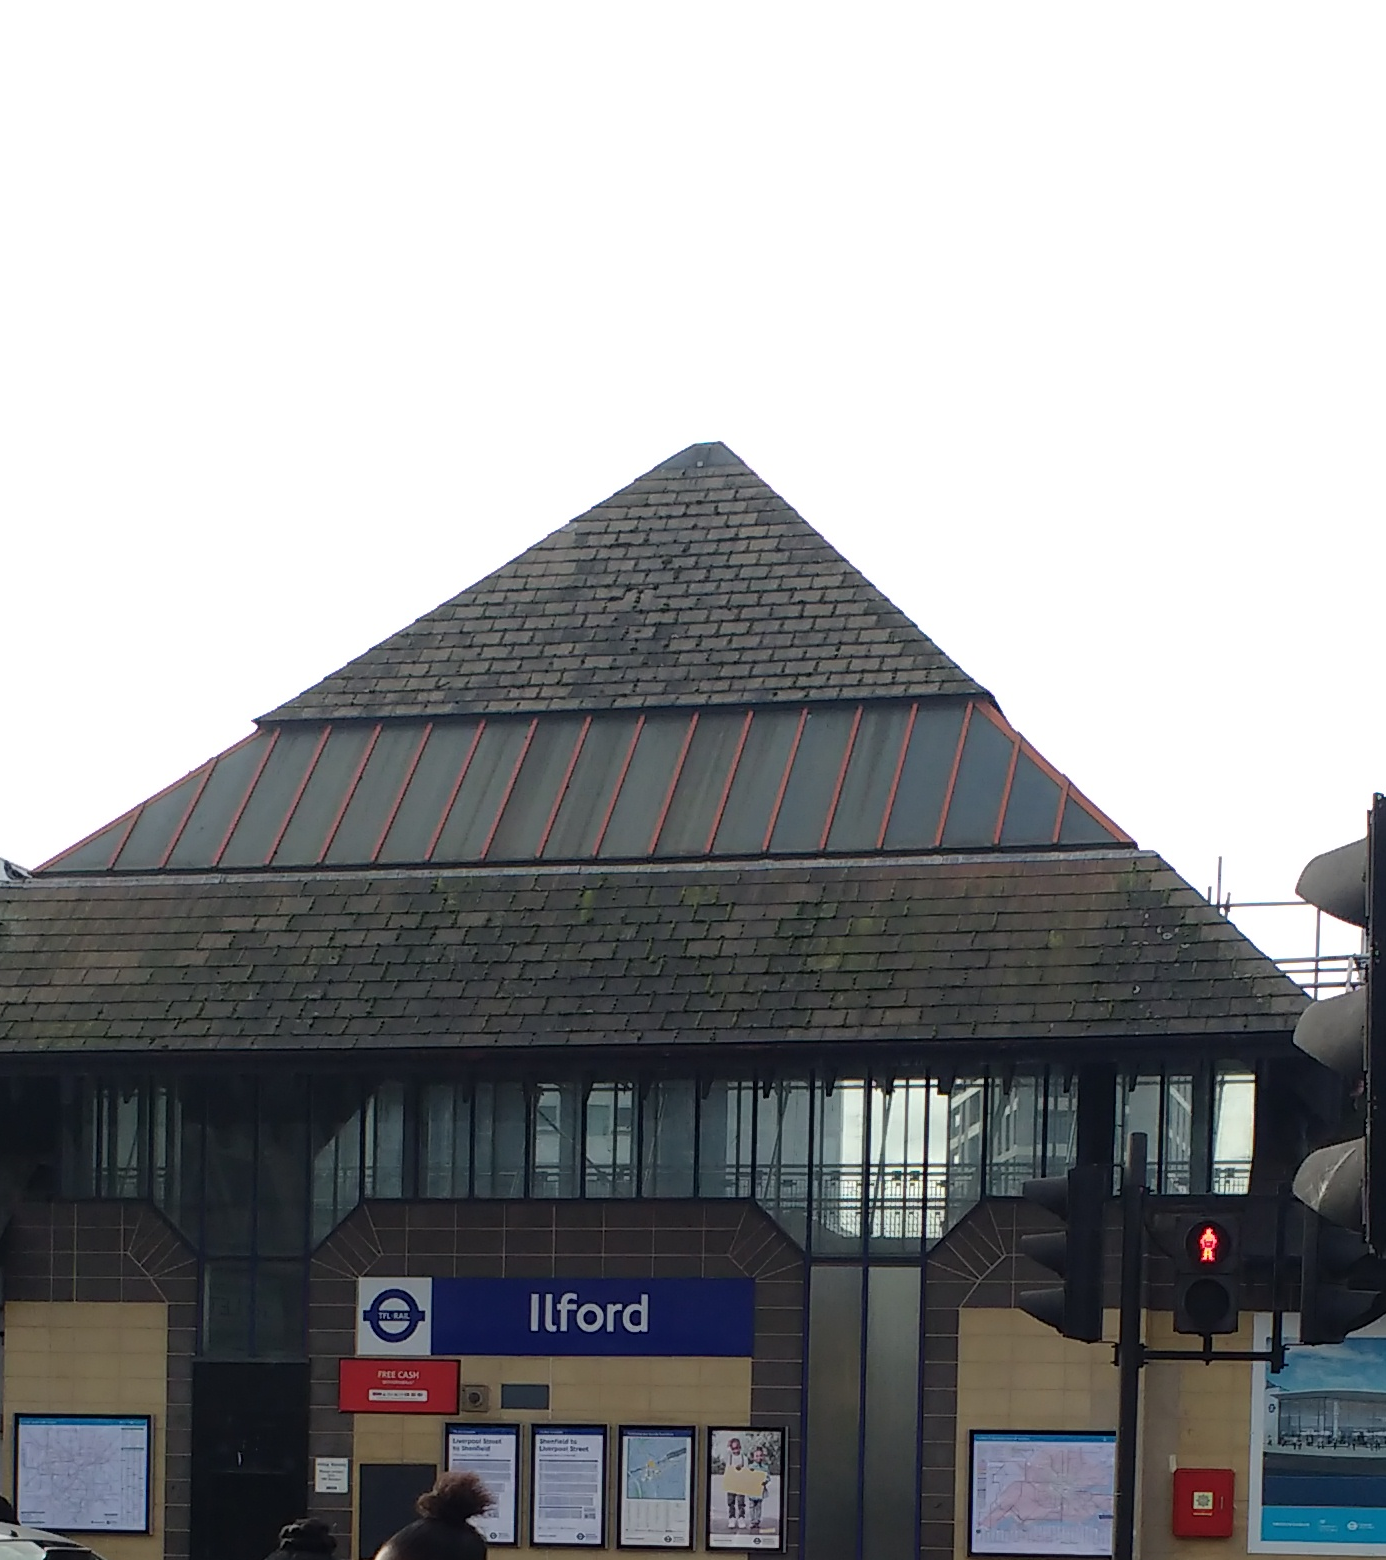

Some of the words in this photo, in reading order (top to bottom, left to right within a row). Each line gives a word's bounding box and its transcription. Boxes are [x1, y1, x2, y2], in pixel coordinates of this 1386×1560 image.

[377, 1311, 392, 1320] TFL
[393, 1311, 411, 1320] RAIL
[529, 1292, 649, 1333] Ilford
[377, 1370, 397, 1379] FREE
[398, 1370, 420, 1380] CASH
[452, 1437, 482, 1447] Liverpool
[483, 1437, 502, 1446] Street
[539, 1437, 569, 1446] Shenfield
[539, 1446, 569, 1454] Liverpool
